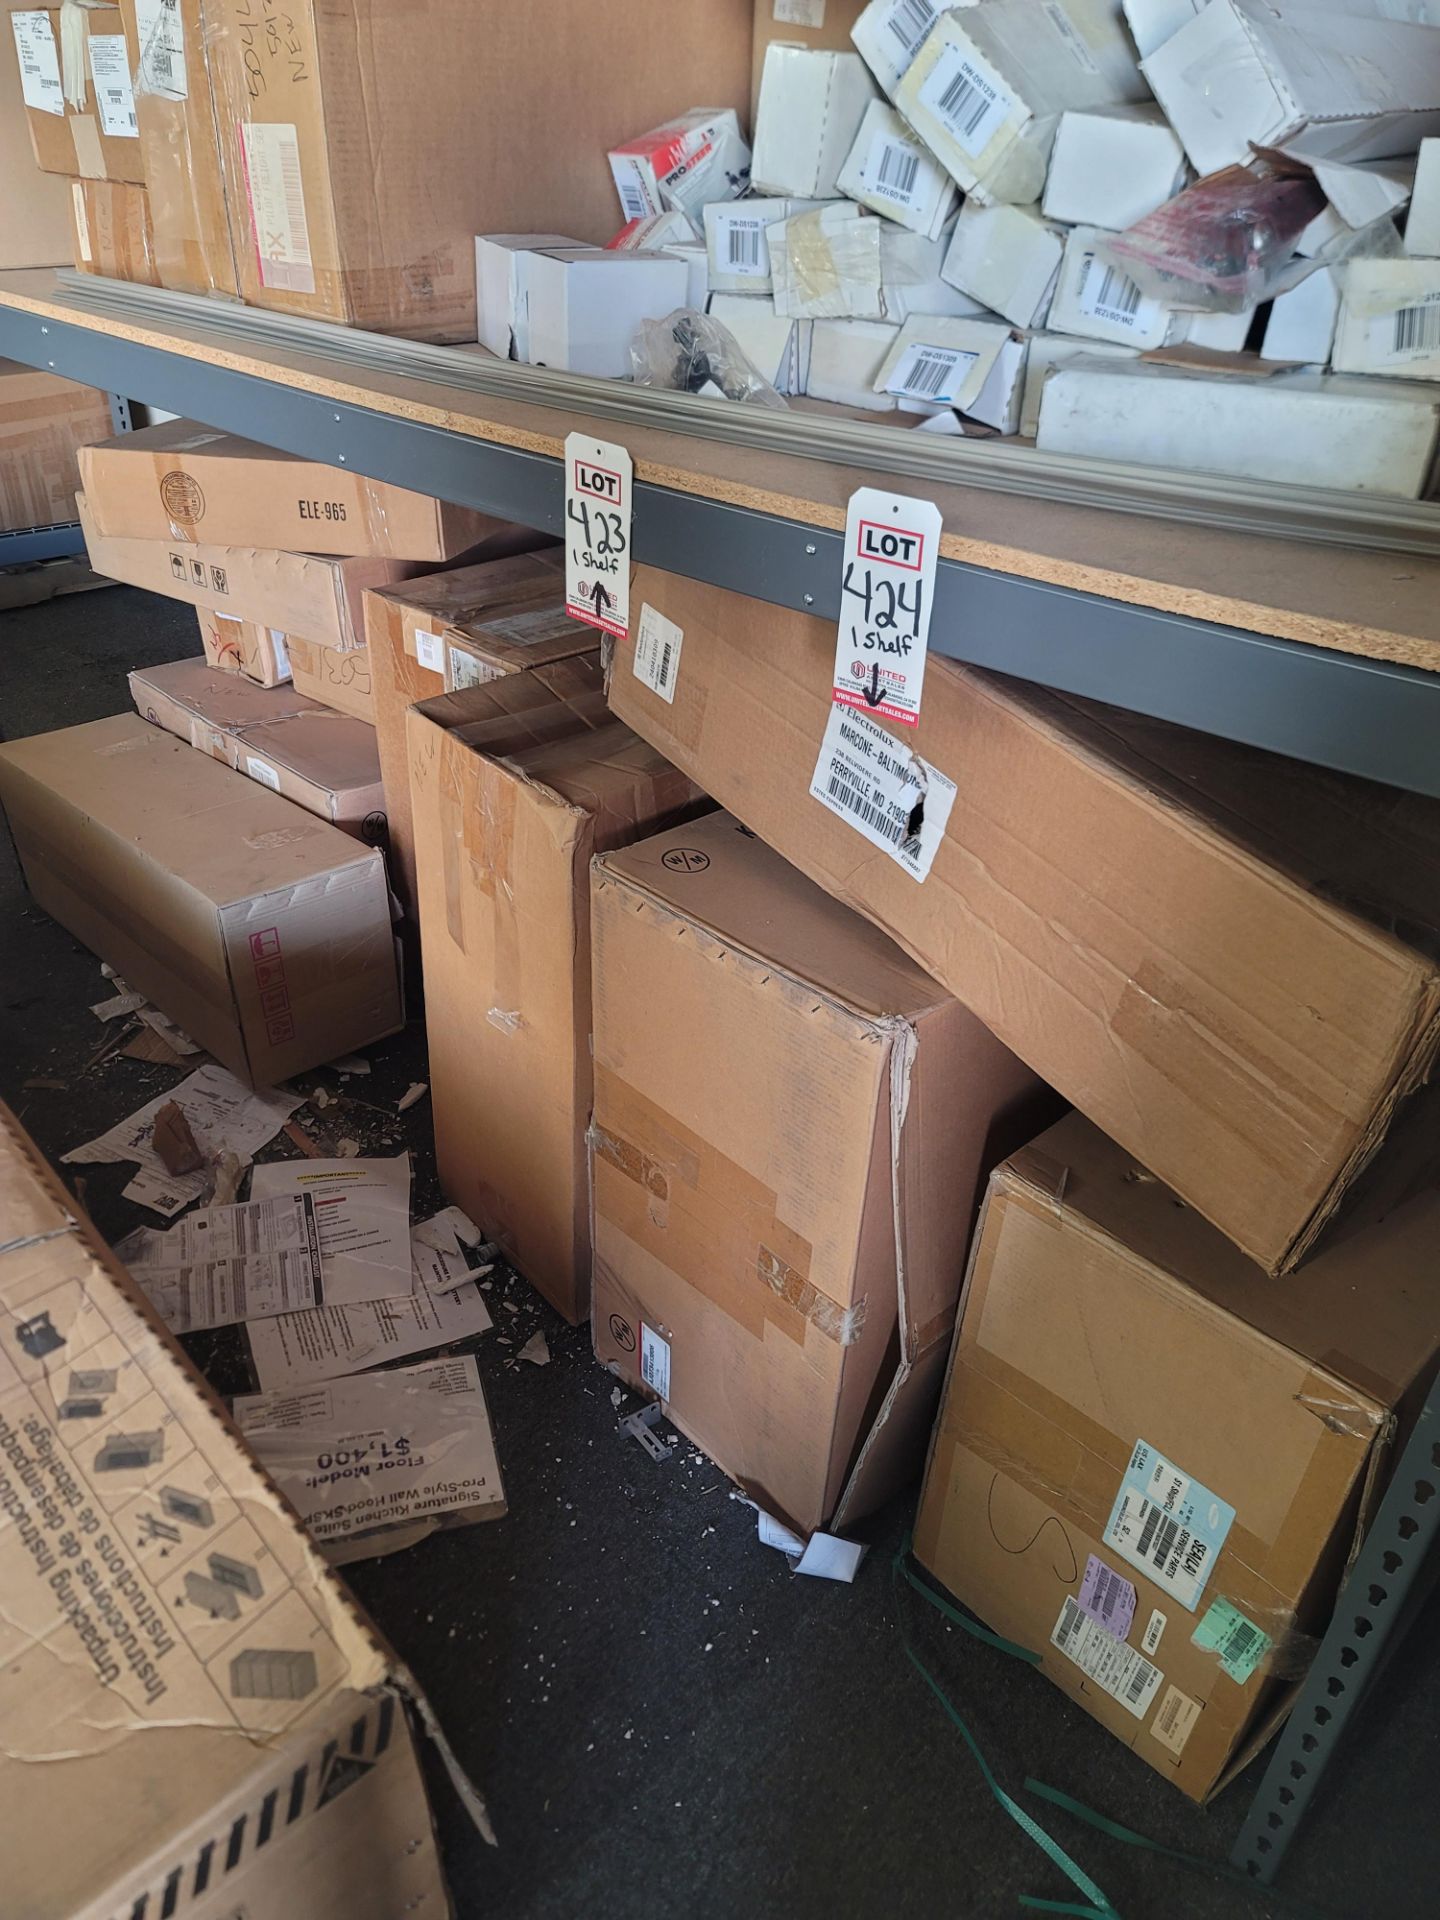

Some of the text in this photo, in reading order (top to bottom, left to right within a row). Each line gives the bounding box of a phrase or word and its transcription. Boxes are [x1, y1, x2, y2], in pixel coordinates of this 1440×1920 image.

[281, 13, 309, 83] NEW
[579, 468, 617, 501] LOT
[298, 499, 347, 522] ELE-965
[567, 498, 627, 555] 423
[581, 550, 620, 575] Shelf
[865, 529, 917, 561] LOT
[842, 562, 924, 638] 424
[863, 626, 914, 658] Shelf
[845, 706, 895, 748] Electrolux
[828, 756, 874, 800] PERRYVILLE,
[870, 789, 886, 808] MD
[314, 1434, 411, 1470] $1,400
[303, 1454, 424, 1489] Floor Model:
[422, 1475, 486, 1496] Pro-Style
[313, 1488, 480, 1536] Signature Kitchen Suite
[388, 1488, 419, 1503] Wall
[72, 1506, 101, 1538] de
[0, 1415, 168, 1702] Instrucciones de desempaqu
[1164, 1529, 1191, 1579] SERVICE PARTS
[1180, 1539, 1207, 1576] SEA(LA)
[91, 1533, 176, 1659] Instructions
[46, 1568, 122, 1686] Unpacking
